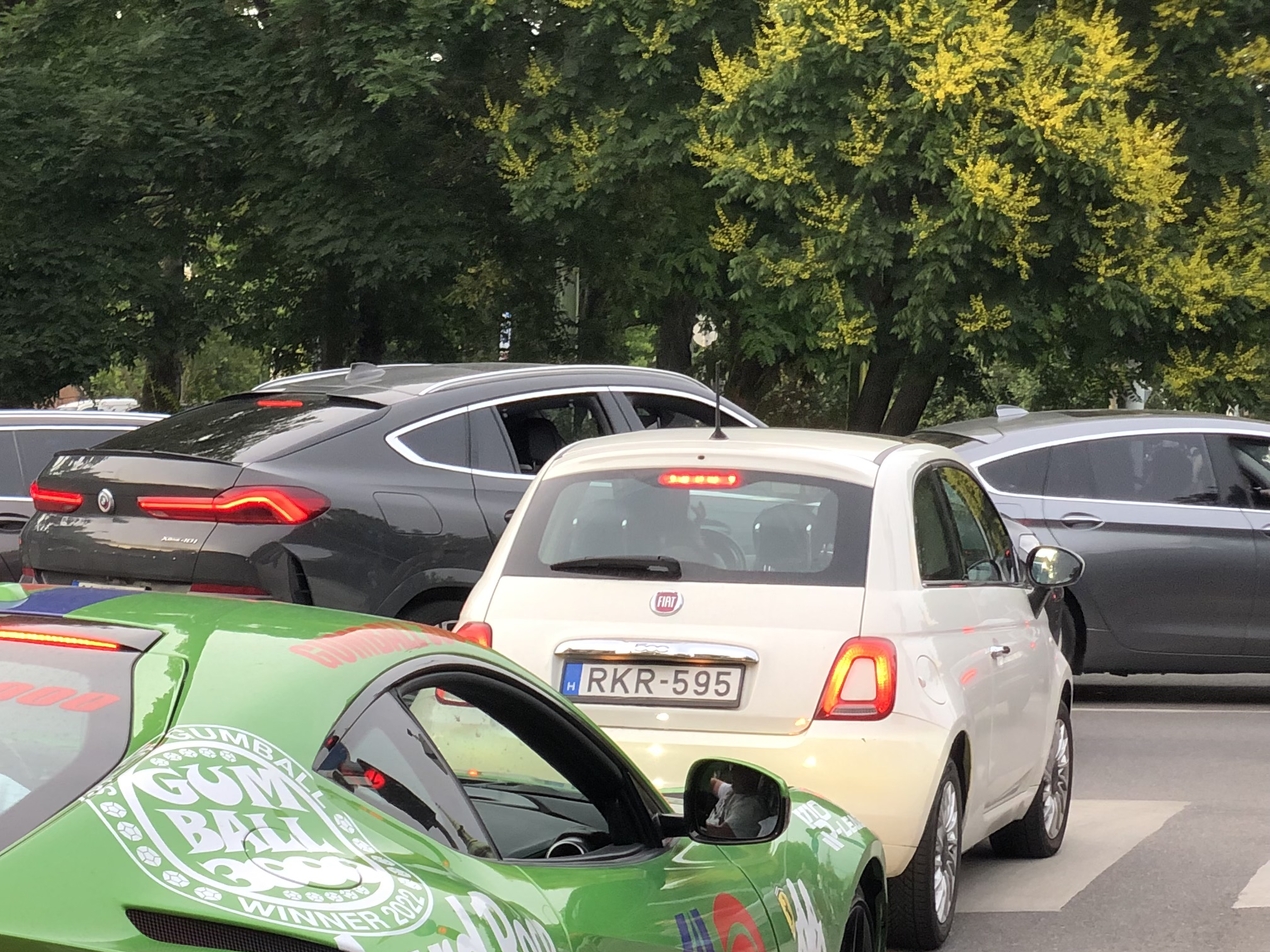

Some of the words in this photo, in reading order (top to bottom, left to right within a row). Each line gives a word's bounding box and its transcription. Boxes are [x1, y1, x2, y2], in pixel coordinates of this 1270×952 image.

[656, 595, 678, 608] FIAT
[566, 681, 576, 692] H
[586, 666, 733, 698] RKR-595
[132, 763, 309, 813] GUM
[166, 726, 329, 810] GUMBALL
[155, 808, 340, 855] BALL
[237, 895, 391, 932] WINNER
[382, 888, 426, 926] 2022
